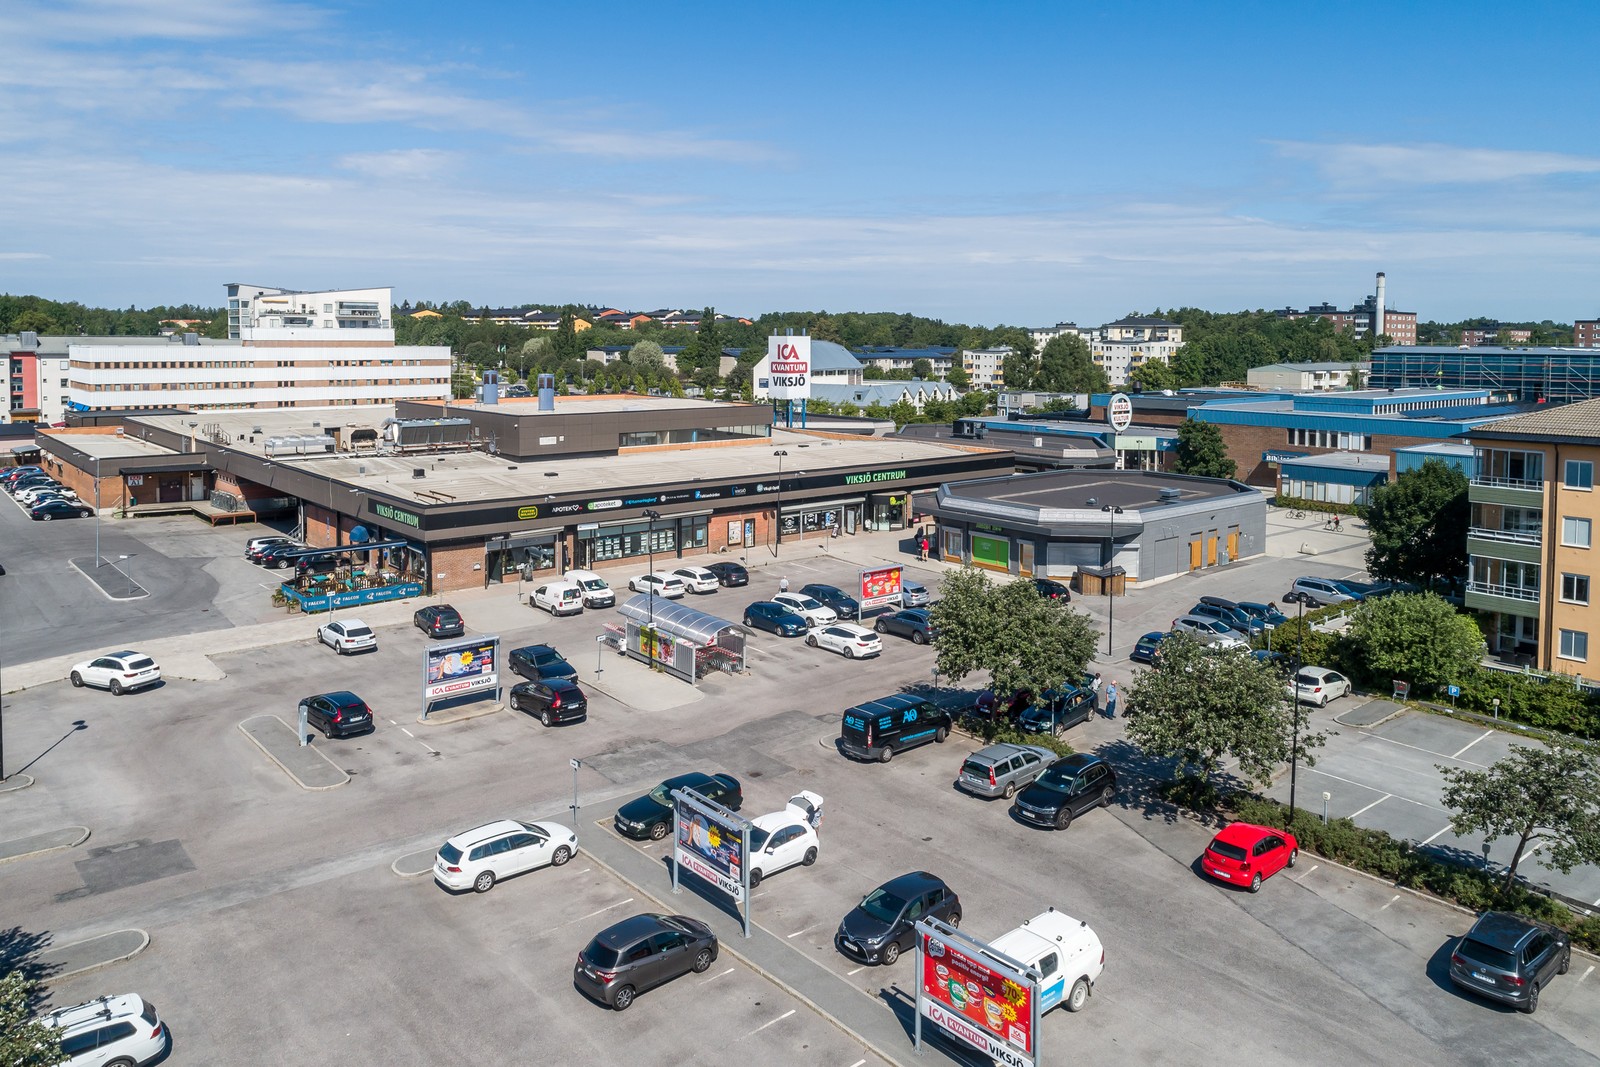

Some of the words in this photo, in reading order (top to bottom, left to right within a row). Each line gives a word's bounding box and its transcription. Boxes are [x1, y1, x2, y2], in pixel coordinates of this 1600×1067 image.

[777, 344, 800, 360] ICA
[772, 363, 806, 371] KVANTUM
[772, 374, 806, 387] VIKSJÖ
[846, 472, 872, 485] VIKSJÖ
[873, 470, 906, 482] CENTRUM
[376, 503, 394, 519] VIKSJÖ
[394, 510, 420, 530] CENTRUM
[552, 505, 573, 513] APOTEK
[445, 682, 470, 692] KVANTUM
[471, 677, 492, 687] VIKSJÖ
[682, 854, 693, 868] ICA
[694, 863, 717, 883] KVANTUM
[718, 877, 740, 896] VIKSJÖ
[929, 1005, 947, 1027] ICA
[948, 1019, 987, 1048] KVANTUM
[988, 1042, 1024, 1067] VIKSJÖ
